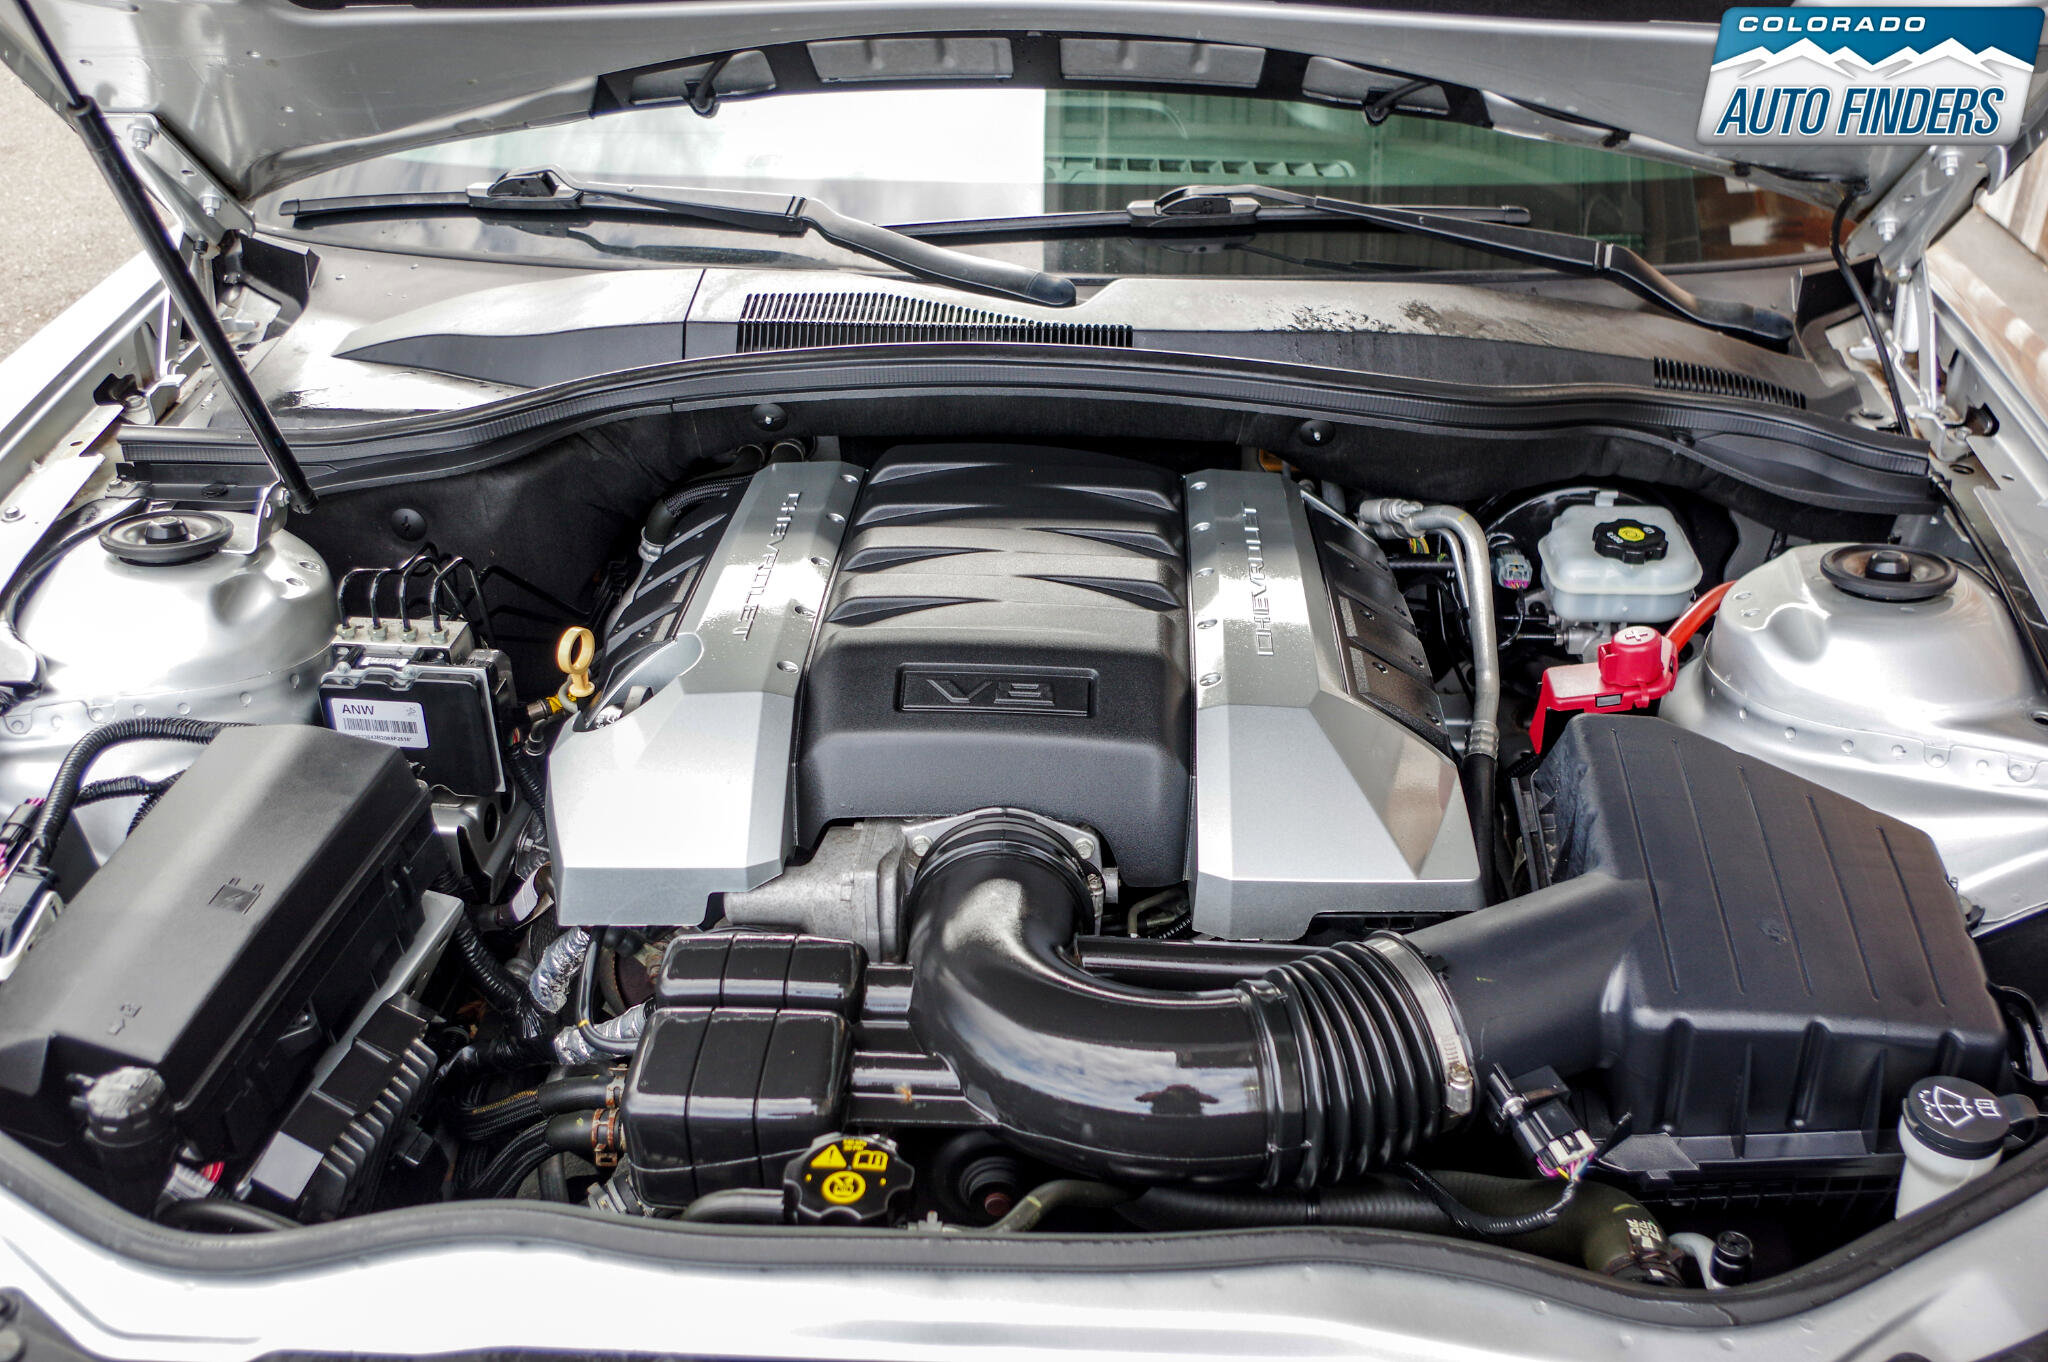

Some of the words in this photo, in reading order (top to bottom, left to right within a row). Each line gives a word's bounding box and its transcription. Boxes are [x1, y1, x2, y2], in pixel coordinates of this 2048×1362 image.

[732, 492, 802, 641] CHEVROLET
[1241, 502, 1274, 656] CHEVROLET
[342, 704, 374, 715] ANW
[926, 679, 1055, 707] V8
